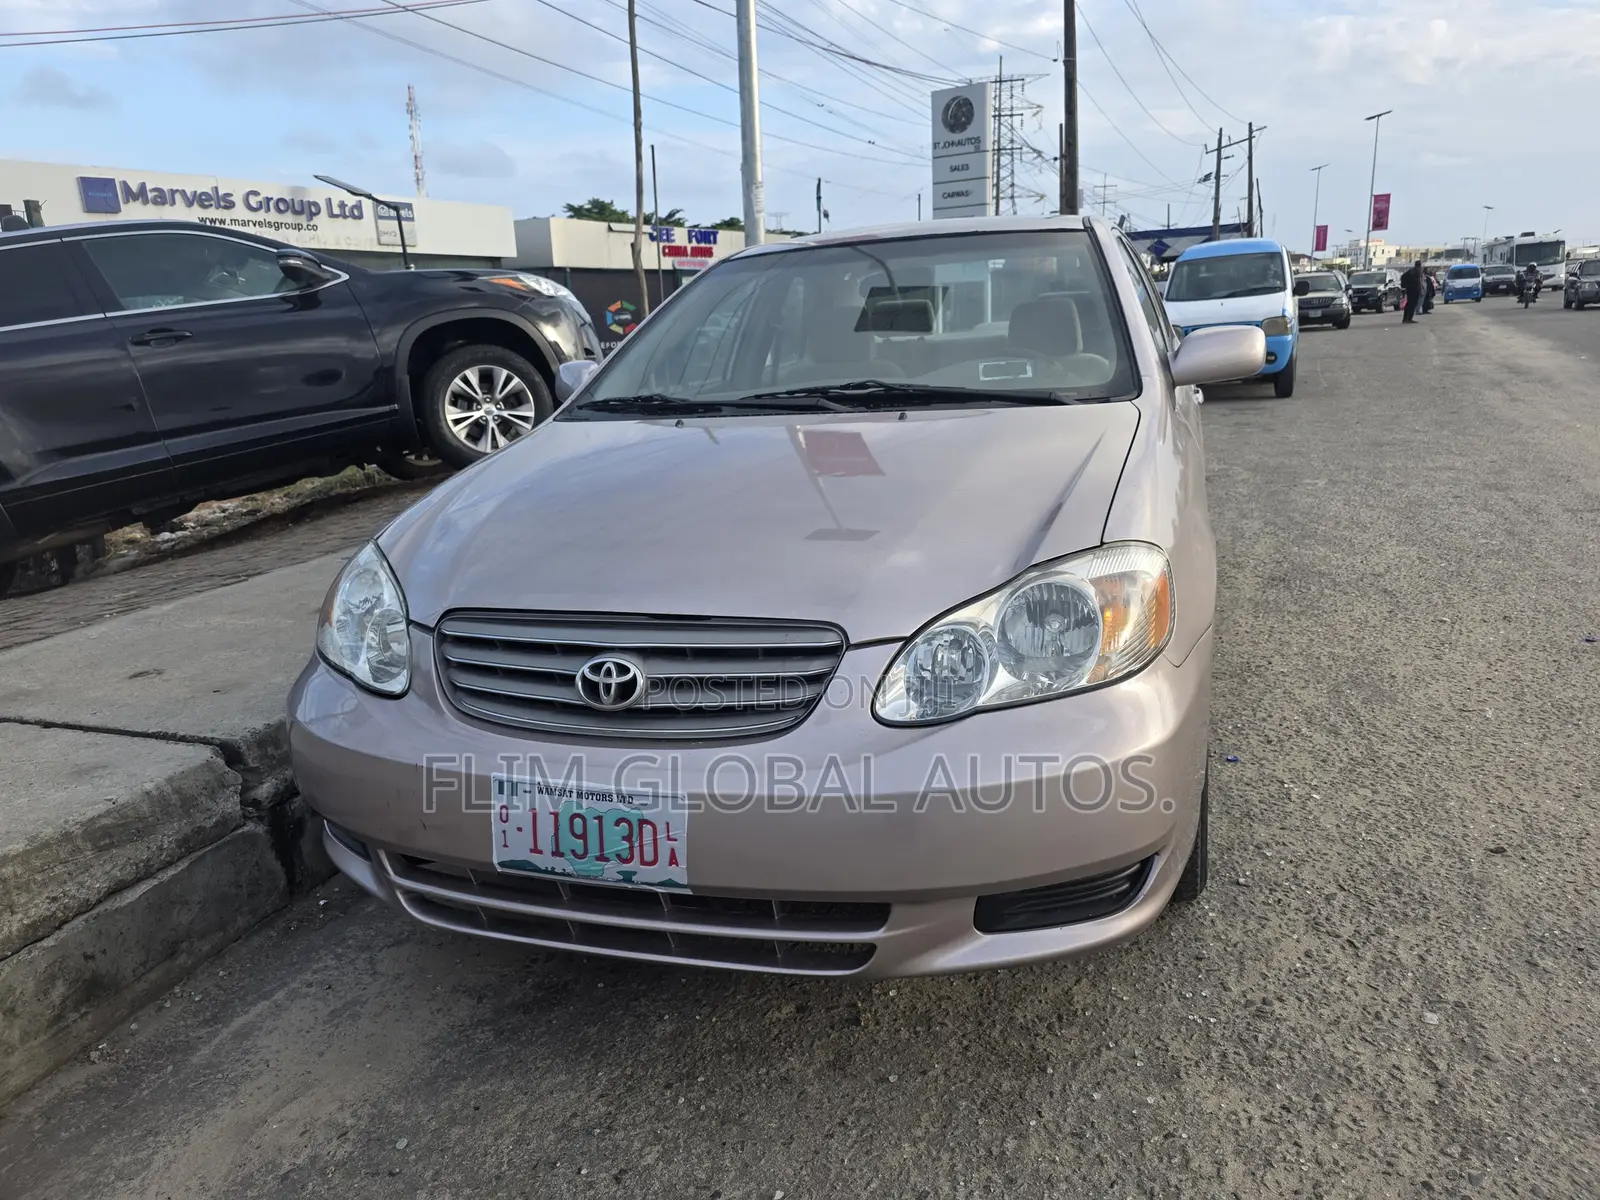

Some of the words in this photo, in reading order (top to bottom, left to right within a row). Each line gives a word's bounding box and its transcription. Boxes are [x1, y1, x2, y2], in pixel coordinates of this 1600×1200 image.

[949, 163, 970, 173] SALES
[119, 179, 236, 211] Marvels
[242, 189, 321, 222] Group
[325, 197, 364, 220] Ltd
[198, 215, 318, 233] www.marvelsgroup.co
[537, 785, 574, 799] WAMSAT
[576, 789, 613, 803] MOTORS
[616, 793, 634, 805] LTD
